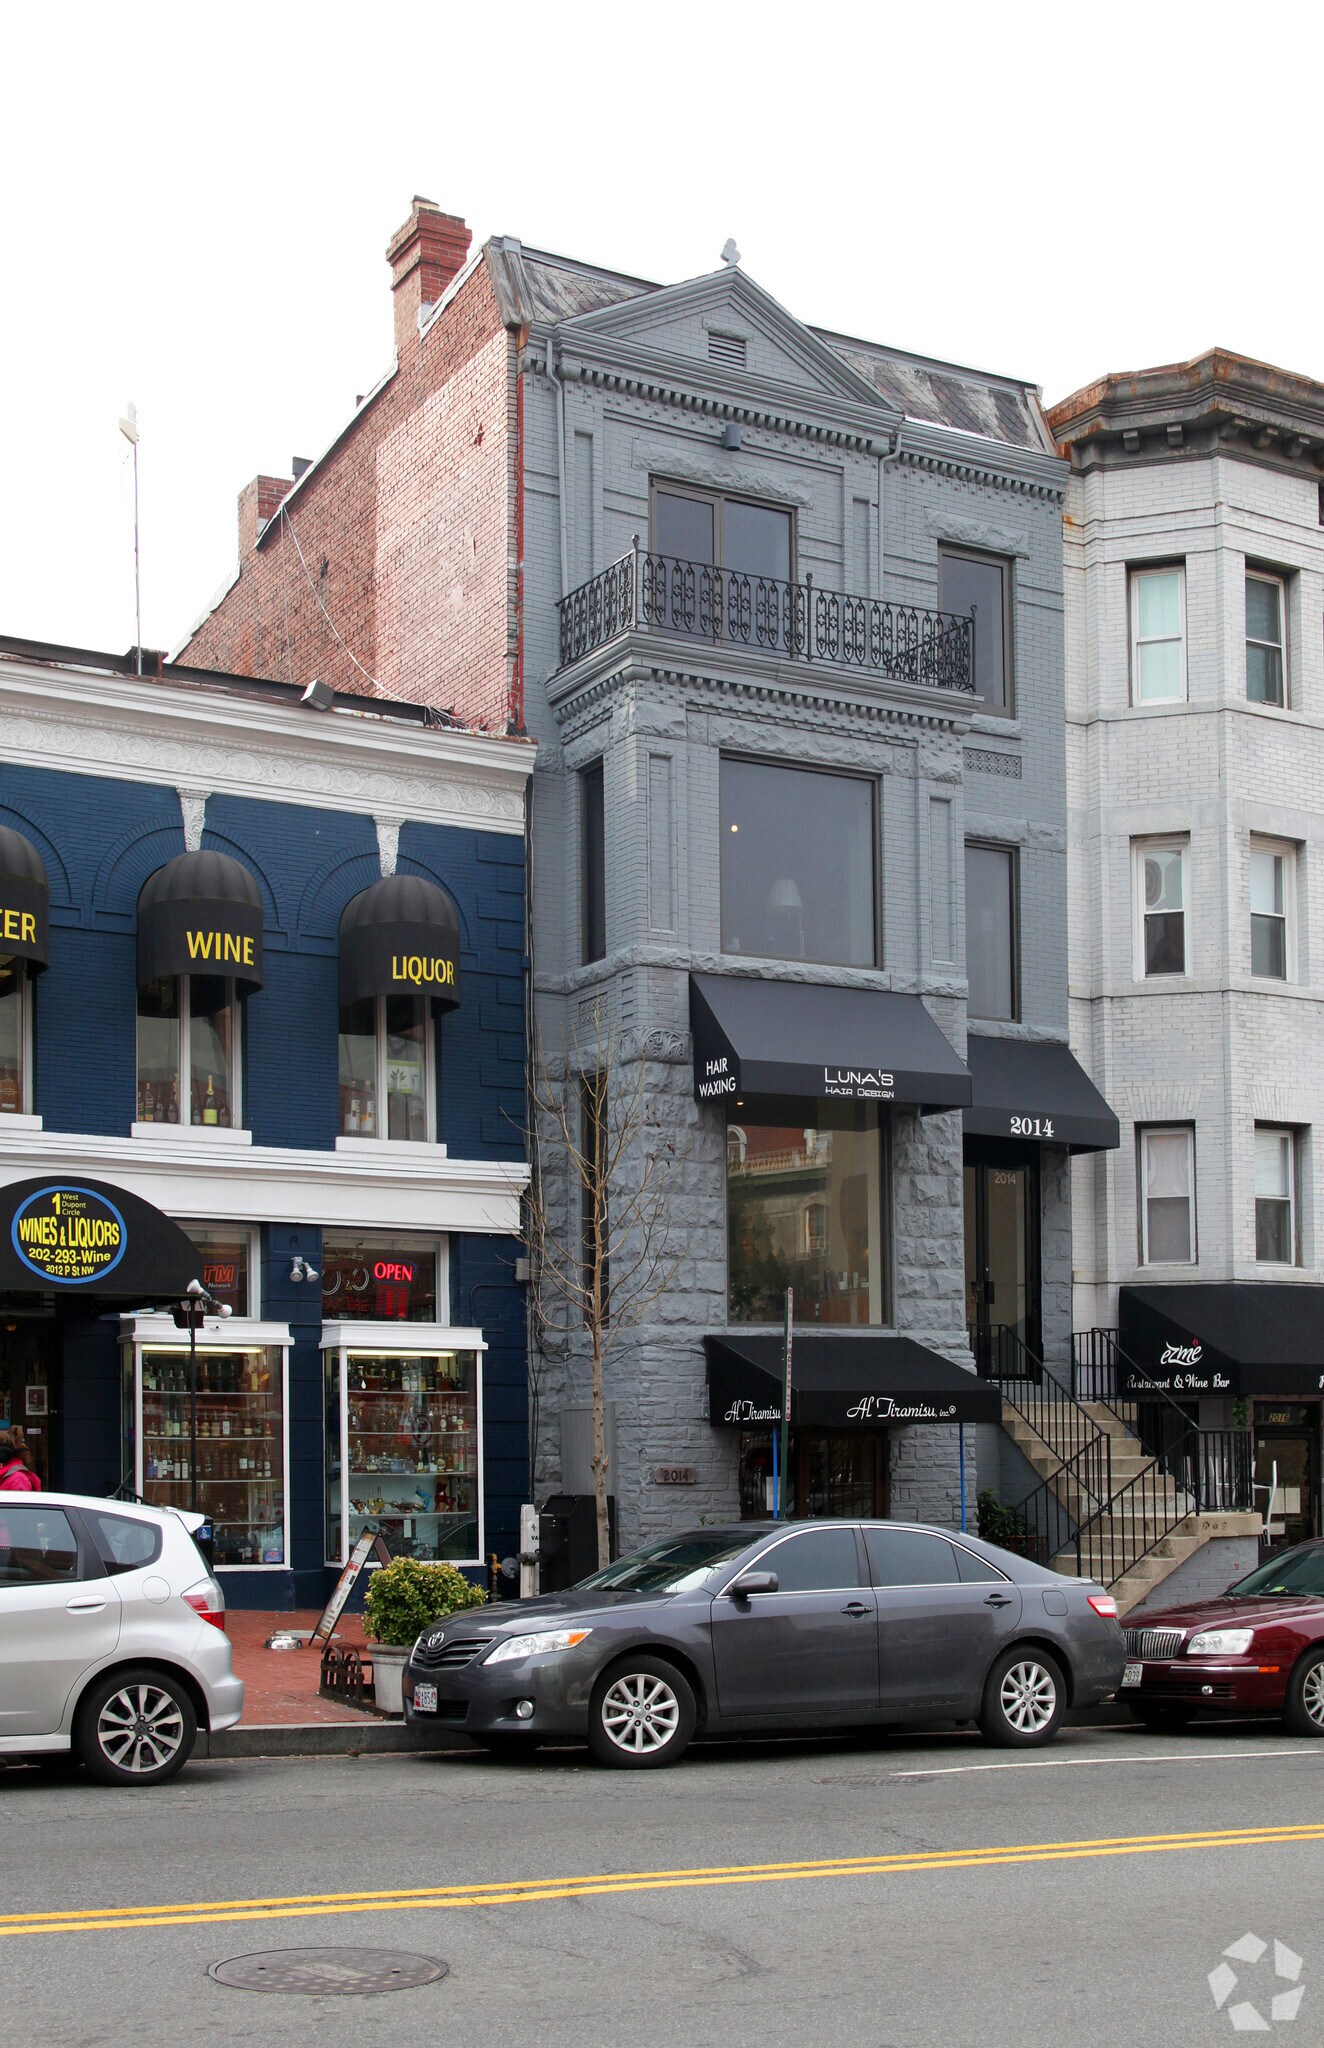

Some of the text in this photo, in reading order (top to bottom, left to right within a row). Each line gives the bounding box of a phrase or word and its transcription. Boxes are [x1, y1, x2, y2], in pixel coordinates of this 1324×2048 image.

[0, 908, 37, 944] ER
[186, 931, 255, 966] WINE
[392, 955, 455, 986] LIQUOR
[706, 1057, 728, 1076] HAIR
[698, 1077, 737, 1098] WAXING
[1010, 1116, 1055, 1138] 2014
[994, 1172, 1017, 1185] 2014
[52, 1192, 61, 1215] 1
[61, 1193, 79, 1201] West
[61, 1201, 87, 1209] Dupont
[61, 1208, 81, 1216] Circle
[19, 1216, 120, 1249] WINES & LIQUORS
[28, 1247, 112, 1264] 202-293-Wine
[45, 1264, 95, 1277] 2012 P St NW
[203, 1264, 236, 1283] TM
[373, 1261, 414, 1282] OPEN
[1173, 1374, 1185, 1389] &
[1185, 1374, 1209, 1389] Wine
[1212, 1373, 1231, 1388] Bar
[724, 1400, 742, 1423] Al
[846, 1396, 876, 1420] Al
[875, 1397, 938, 1419] Tiramisu,
[663, 1469, 689, 1482] 2014
